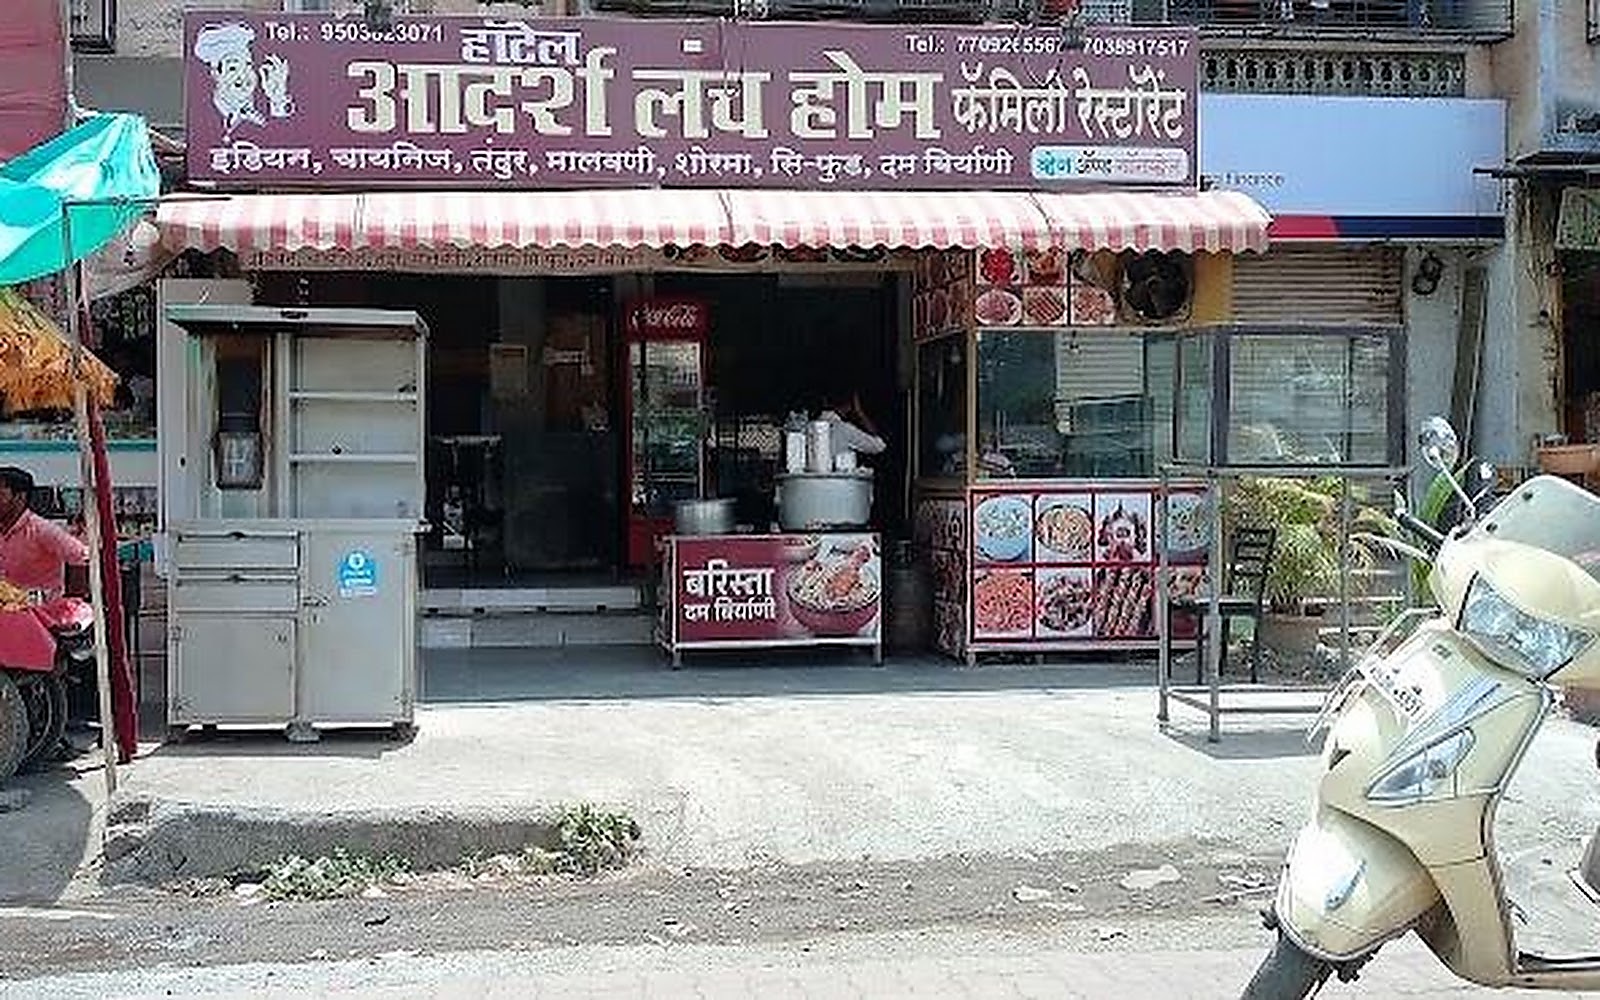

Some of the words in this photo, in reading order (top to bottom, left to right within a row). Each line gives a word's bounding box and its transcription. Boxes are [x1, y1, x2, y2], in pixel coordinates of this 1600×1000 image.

[264, 22, 311, 42] Tel.:
[905, 34, 944, 52] Tel.:
[347, 47, 617, 136] आदर्श
[632, 39, 771, 138] लंच
[789, 51, 943, 138] होम
[880, 154, 918, 178] दम
[683, 559, 775, 597] बरिस्ता
